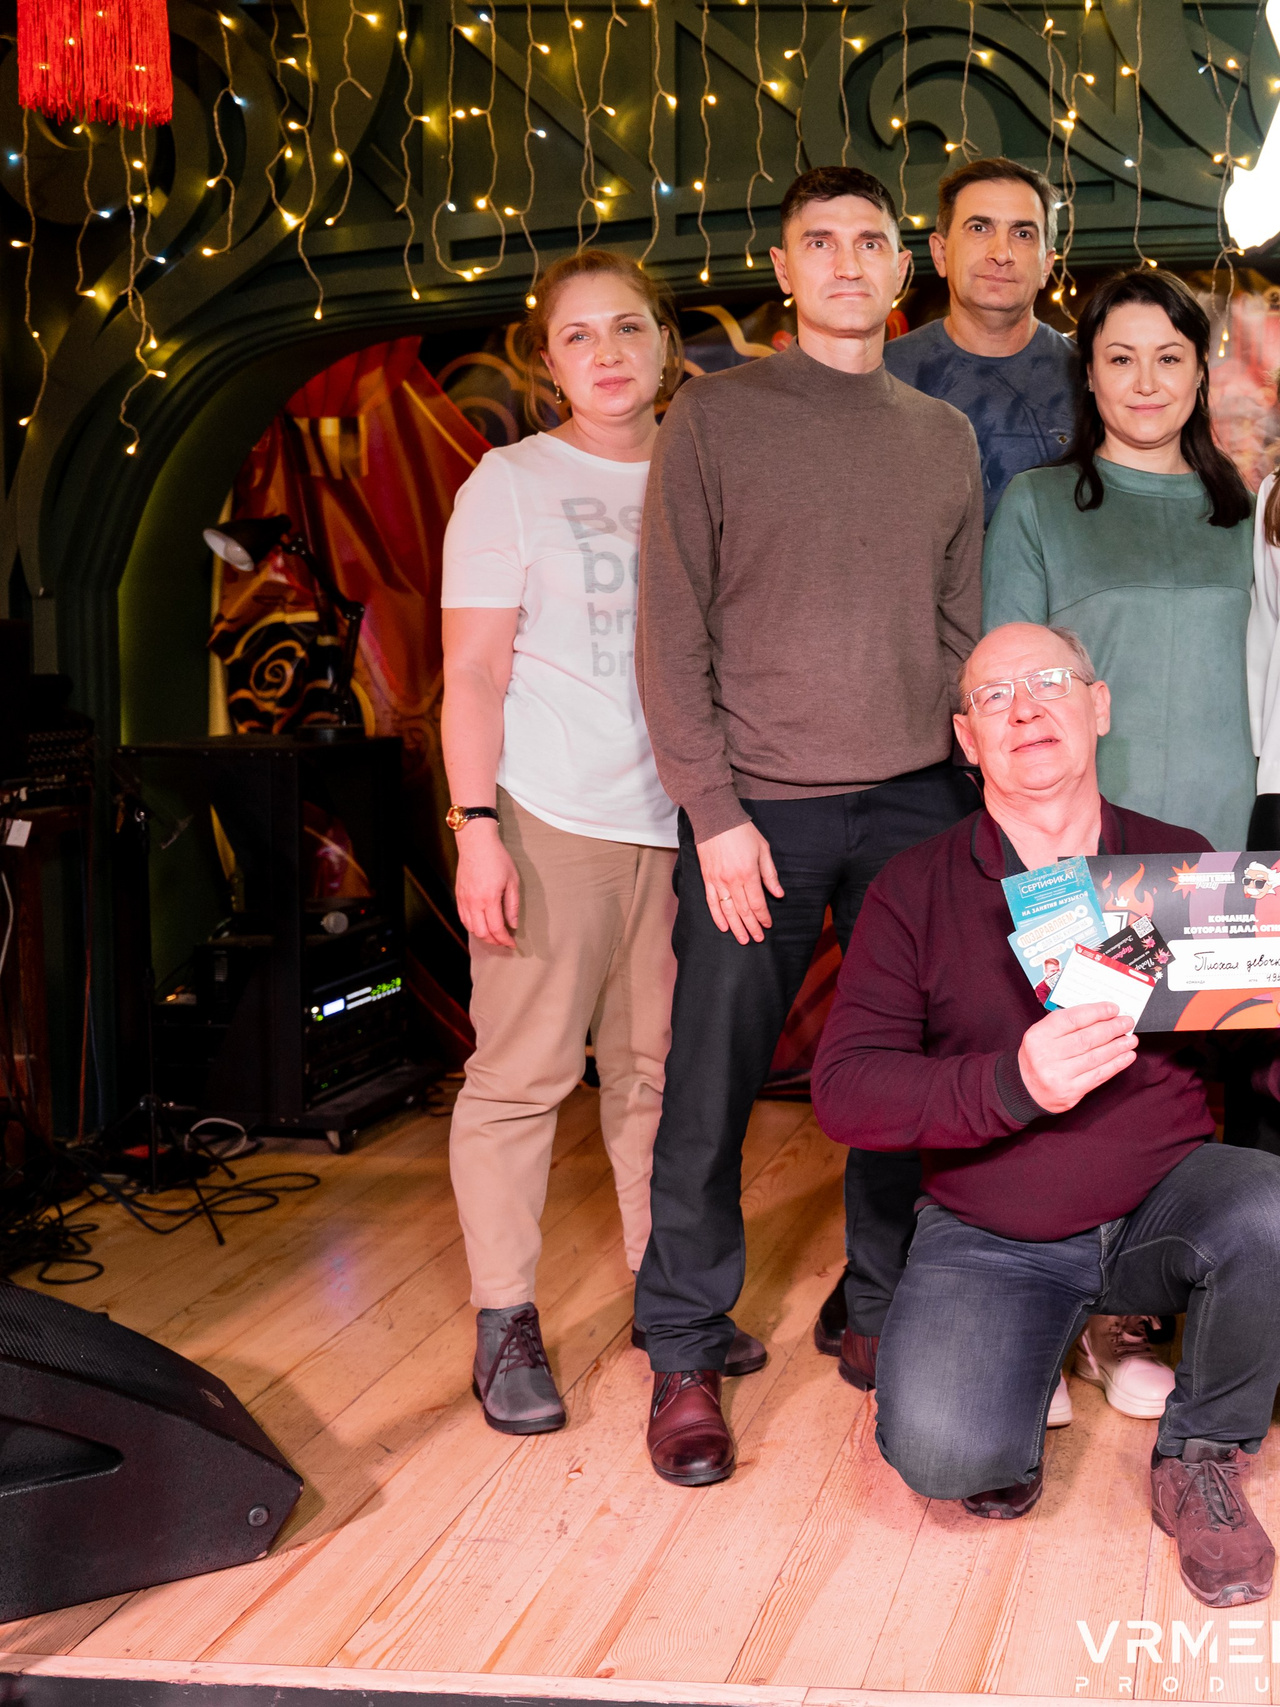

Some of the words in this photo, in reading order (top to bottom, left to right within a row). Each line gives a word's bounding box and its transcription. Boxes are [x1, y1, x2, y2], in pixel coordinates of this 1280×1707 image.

[1020, 871, 1075, 894] СЕРТИФИКАТ
[1019, 912, 1074, 946] ПОЗДРАВЛЯЕМ
[1183, 926, 1228, 934] КОТОРАЯ
[1229, 925, 1259, 934] ДАЛА
[1193, 950, 1239, 972] Плохая
